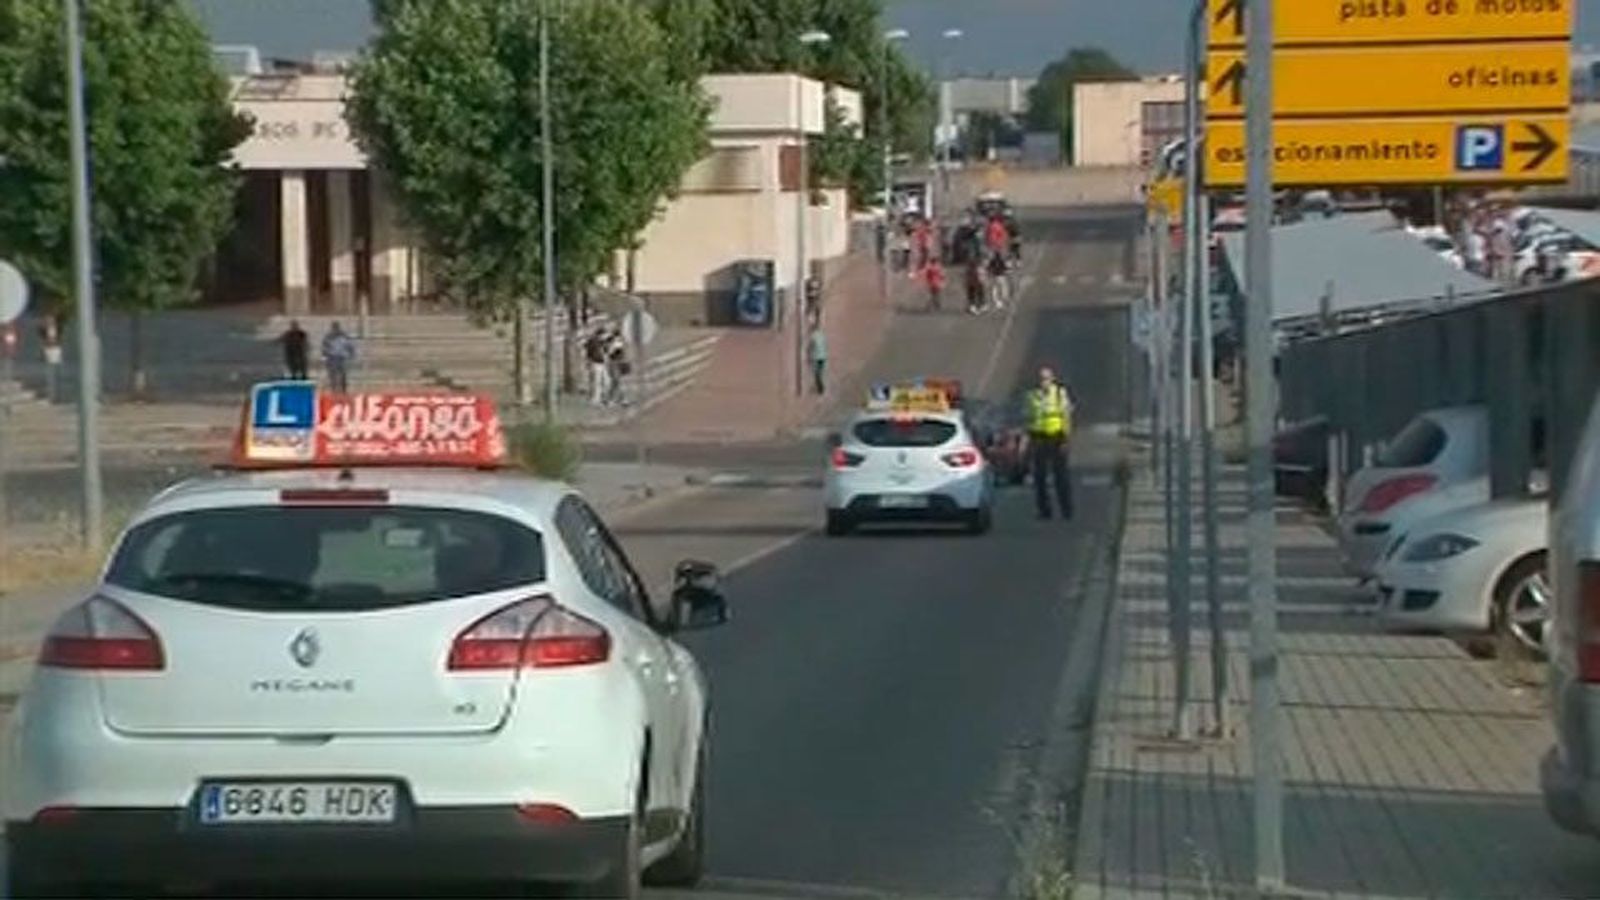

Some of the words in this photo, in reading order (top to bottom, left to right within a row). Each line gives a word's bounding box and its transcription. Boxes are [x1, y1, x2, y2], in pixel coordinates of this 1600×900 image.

[1340, 0, 1406, 22] pista
[1426, 0, 1459, 16] de
[1475, 0, 1562, 14] motos
[1448, 66, 1558, 88] oficinas
[1214, 140, 1440, 163] escionamiento
[1463, 128, 1498, 167] P
[268, 391, 297, 423] L
